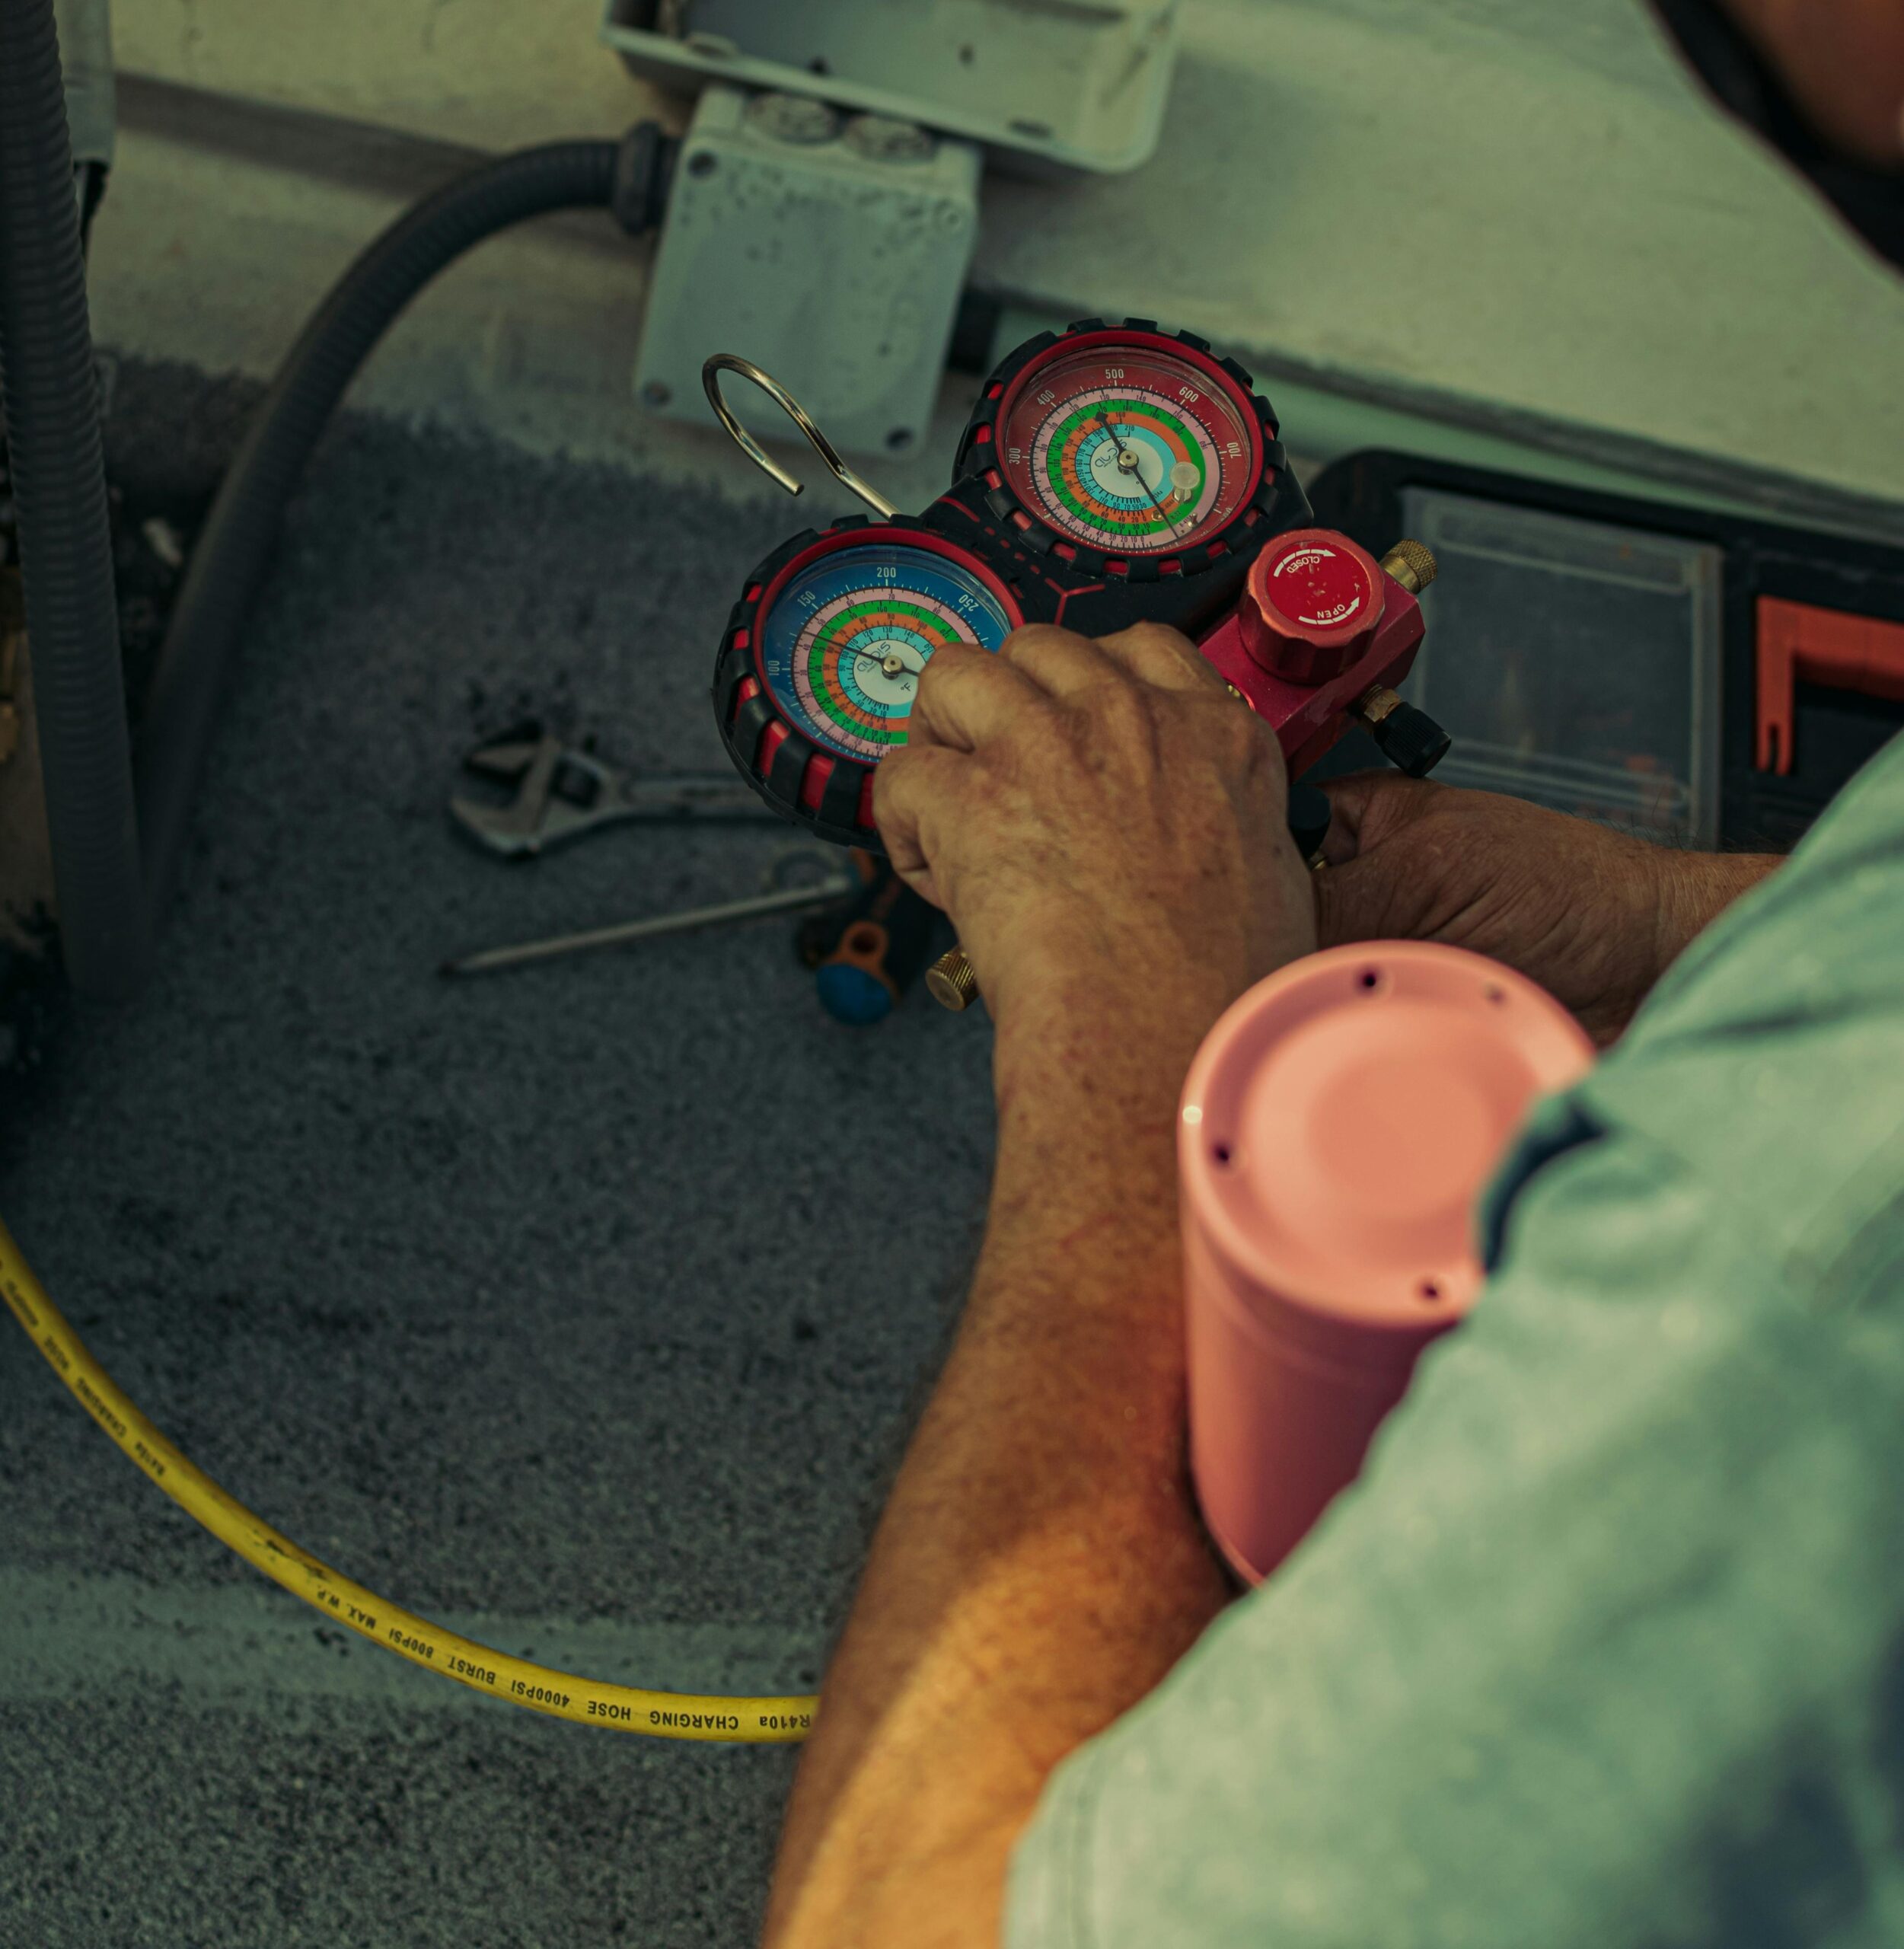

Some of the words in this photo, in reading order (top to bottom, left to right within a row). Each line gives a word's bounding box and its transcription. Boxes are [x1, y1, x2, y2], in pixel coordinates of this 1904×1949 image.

[1105, 368, 1124, 379] 500
[1037, 390, 1056, 405] 400
[1178, 386, 1199, 402] 600
[1173, 411, 1183, 419] 150
[1009, 448, 1021, 464] 300
[1226, 442, 1242, 458] 700
[1287, 556, 1320, 573] CLOSED
[877, 567, 896, 578] 200
[797, 591, 815, 607] 150
[958, 595, 979, 611] 250
[1317, 604, 1345, 619] OPEN
[863, 630, 873, 638] 120
[904, 630, 915, 639] 140
[849, 639, 859, 647] 110
[923, 643, 933, 653] 150
[768, 660, 780, 675] 100
[388, 1628, 434, 1659] 800PSI
[448, 1656, 496, 1685] BURST
[511, 1679, 570, 1708] 4000PSI
[588, 1700, 630, 1720] HOSE
[649, 1710, 739, 1730] CHARGING
[759, 1714, 811, 1729] R410a
